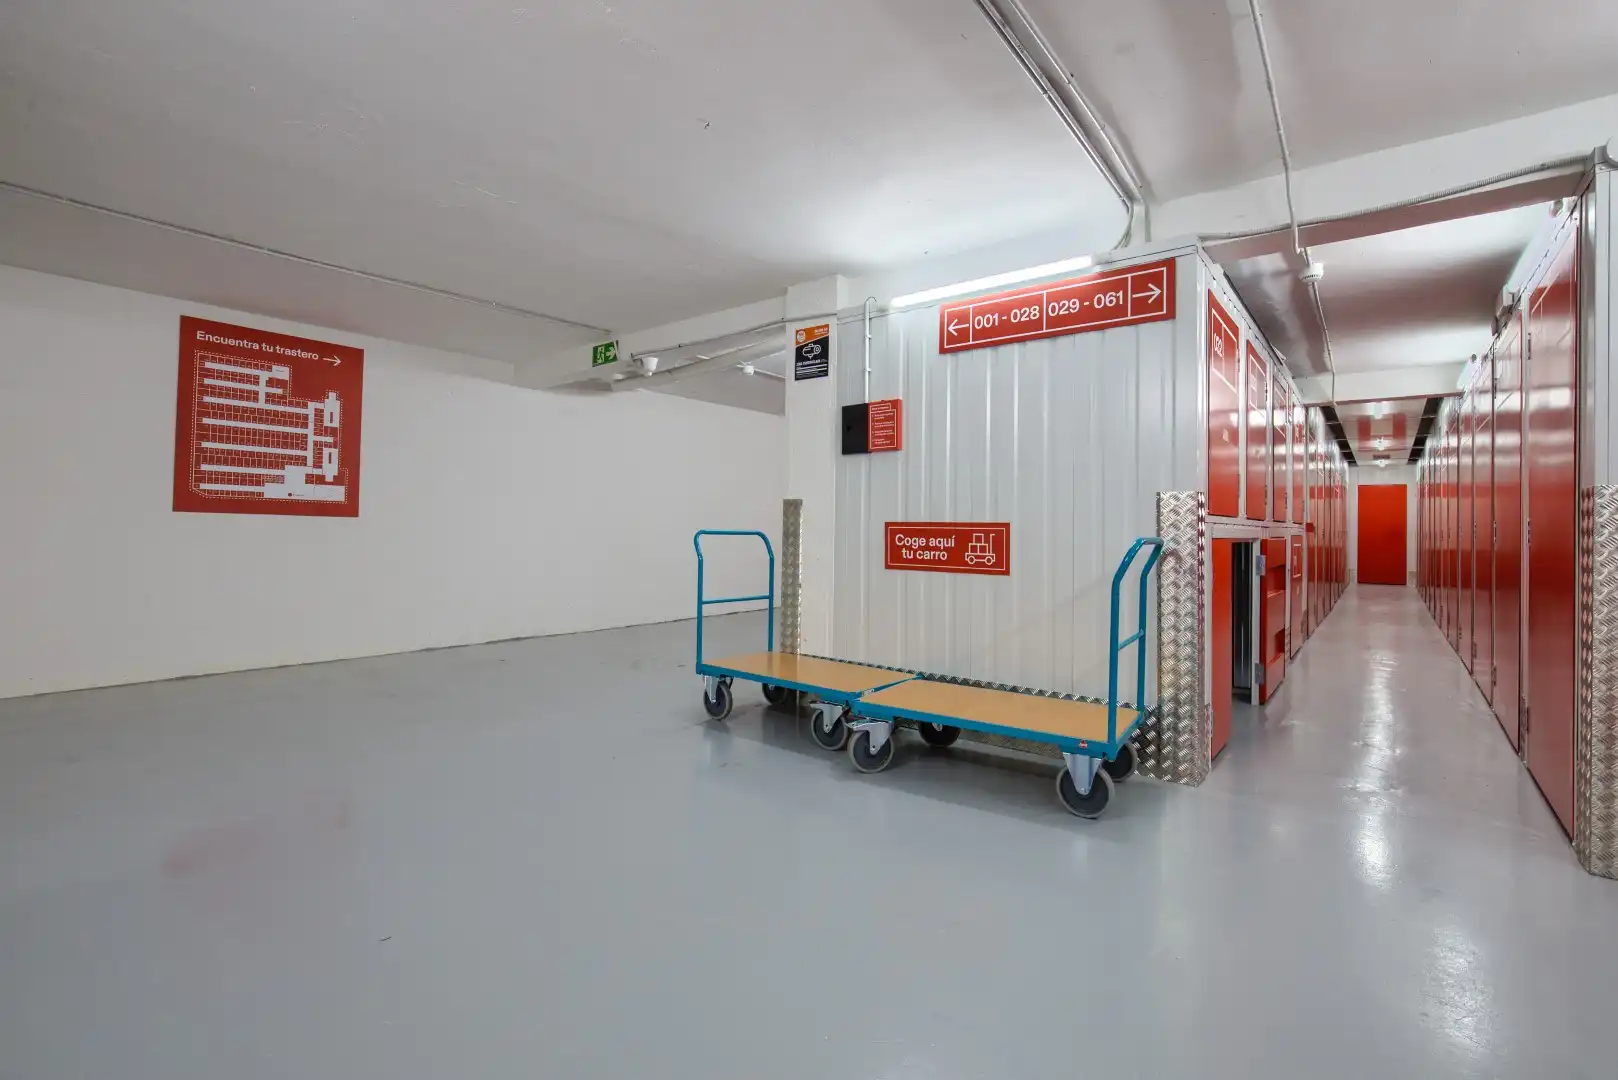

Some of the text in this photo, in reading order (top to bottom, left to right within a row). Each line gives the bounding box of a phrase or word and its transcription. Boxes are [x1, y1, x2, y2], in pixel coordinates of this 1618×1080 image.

[1047, 299, 1080, 317] 029
[1093, 290, 1124, 309] 061
[974, 312, 999, 330] 001
[1010, 306, 1040, 323] 028
[196, 330, 319, 360] Encuentra tu trastero
[895, 534, 956, 550] Coge aquí
[901, 547, 948, 560] tu carro
